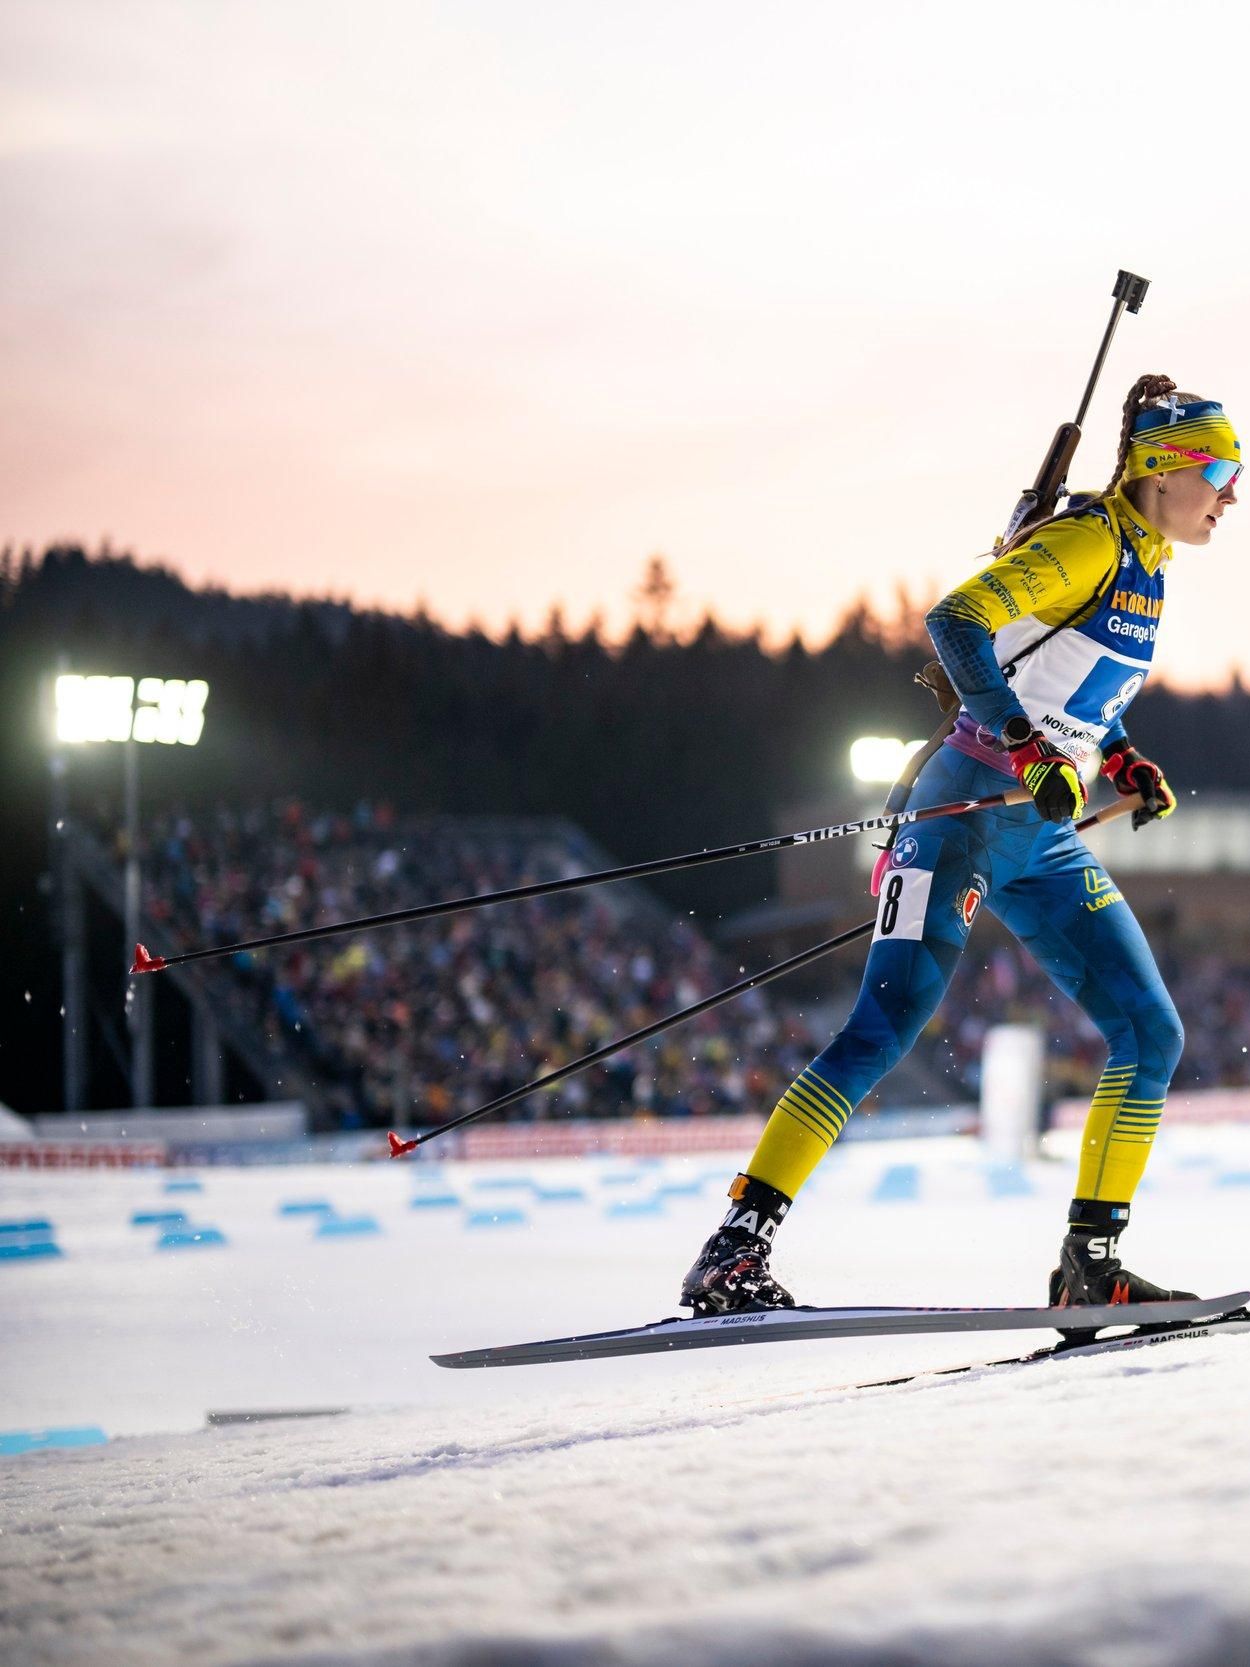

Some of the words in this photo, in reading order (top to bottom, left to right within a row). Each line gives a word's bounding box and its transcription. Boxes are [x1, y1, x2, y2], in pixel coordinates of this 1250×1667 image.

[1159, 445, 1211, 462] NAFGAZ
[1042, 547, 1071, 587] NAFTOGAZ
[1107, 615, 1149, 644] Garage
[793, 810, 917, 845] MADSHUS
[880, 874, 904, 936] 8
[721, 1315, 767, 1326] MADSHUS
[1149, 1329, 1209, 1345] MADSHUS
